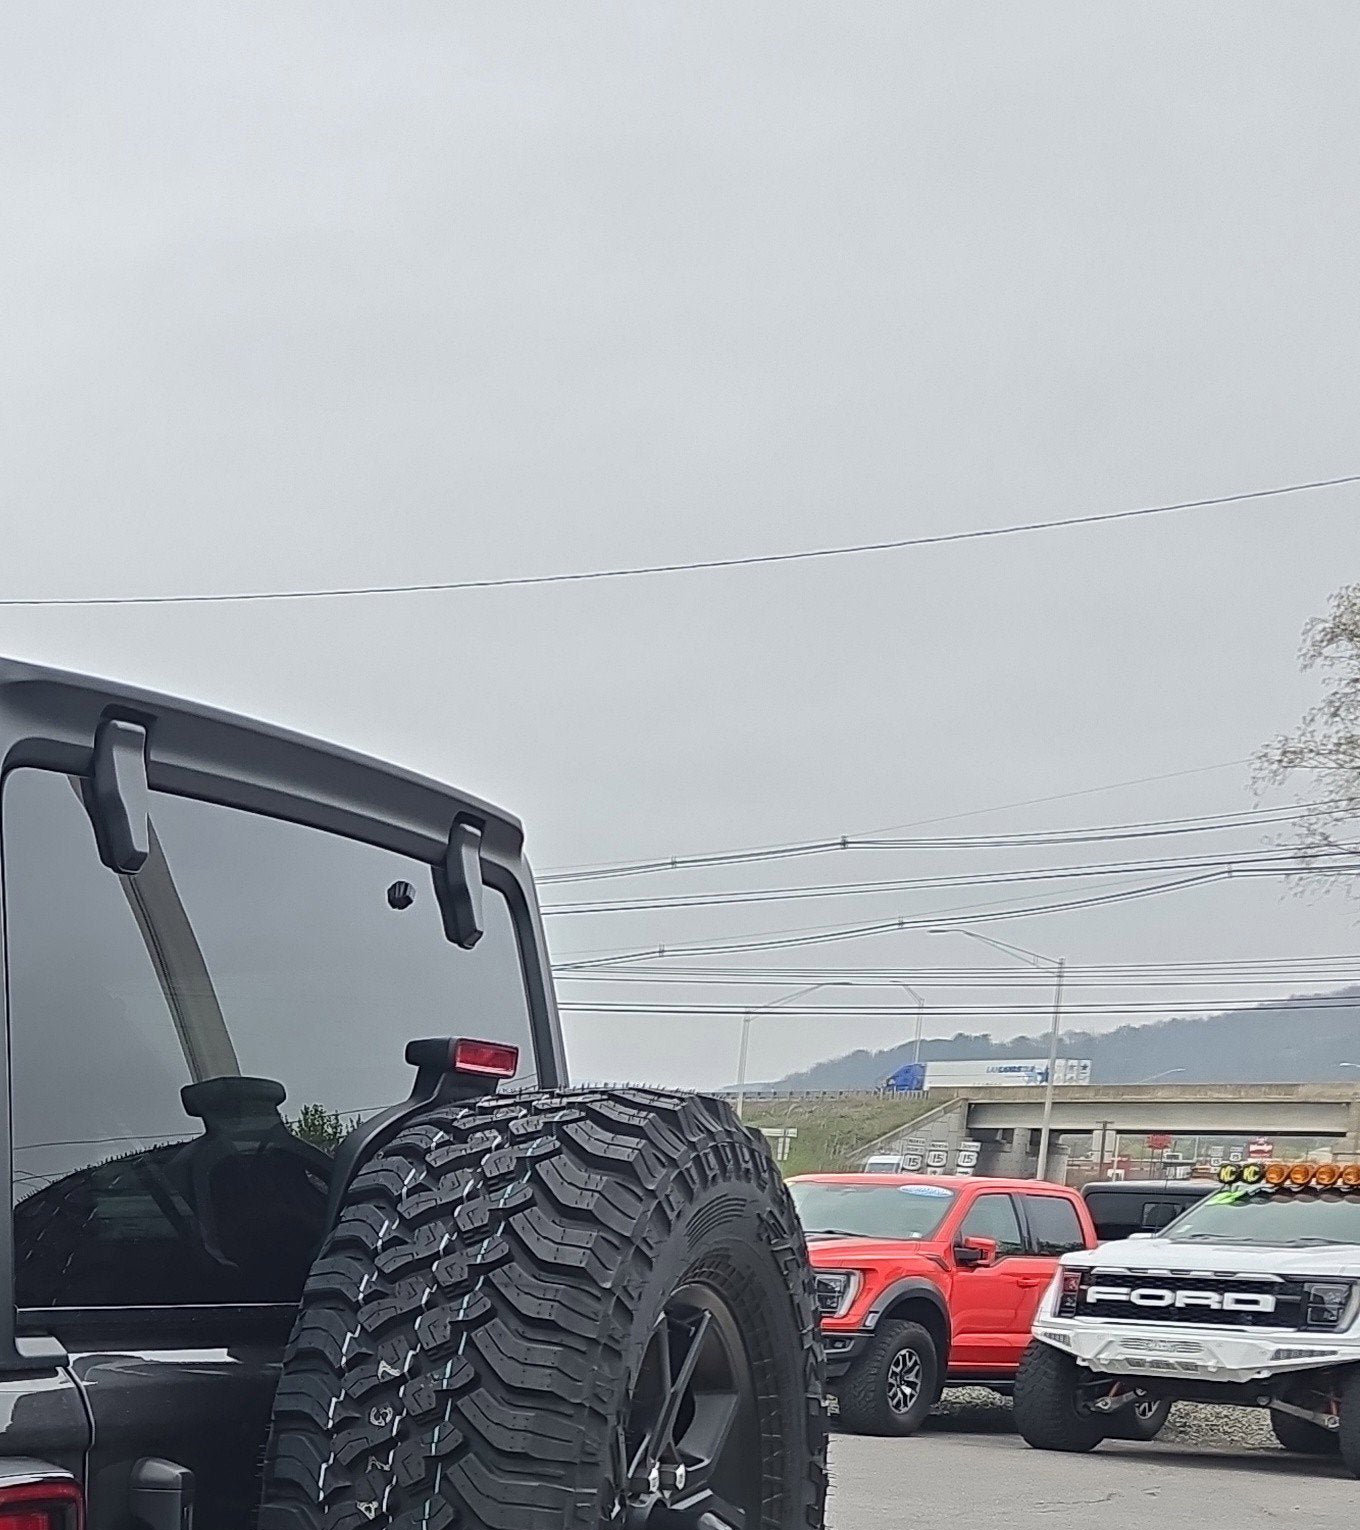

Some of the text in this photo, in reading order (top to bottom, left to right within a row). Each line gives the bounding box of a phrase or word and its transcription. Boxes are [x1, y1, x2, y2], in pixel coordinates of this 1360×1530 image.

[908, 1157, 919, 1166] 15
[933, 1154, 943, 1163] 15
[964, 1154, 974, 1163] 15
[1220, 1165, 1237, 1182] KC
[1243, 1165, 1260, 1181] KC
[1086, 1286, 1276, 1313] FORD
